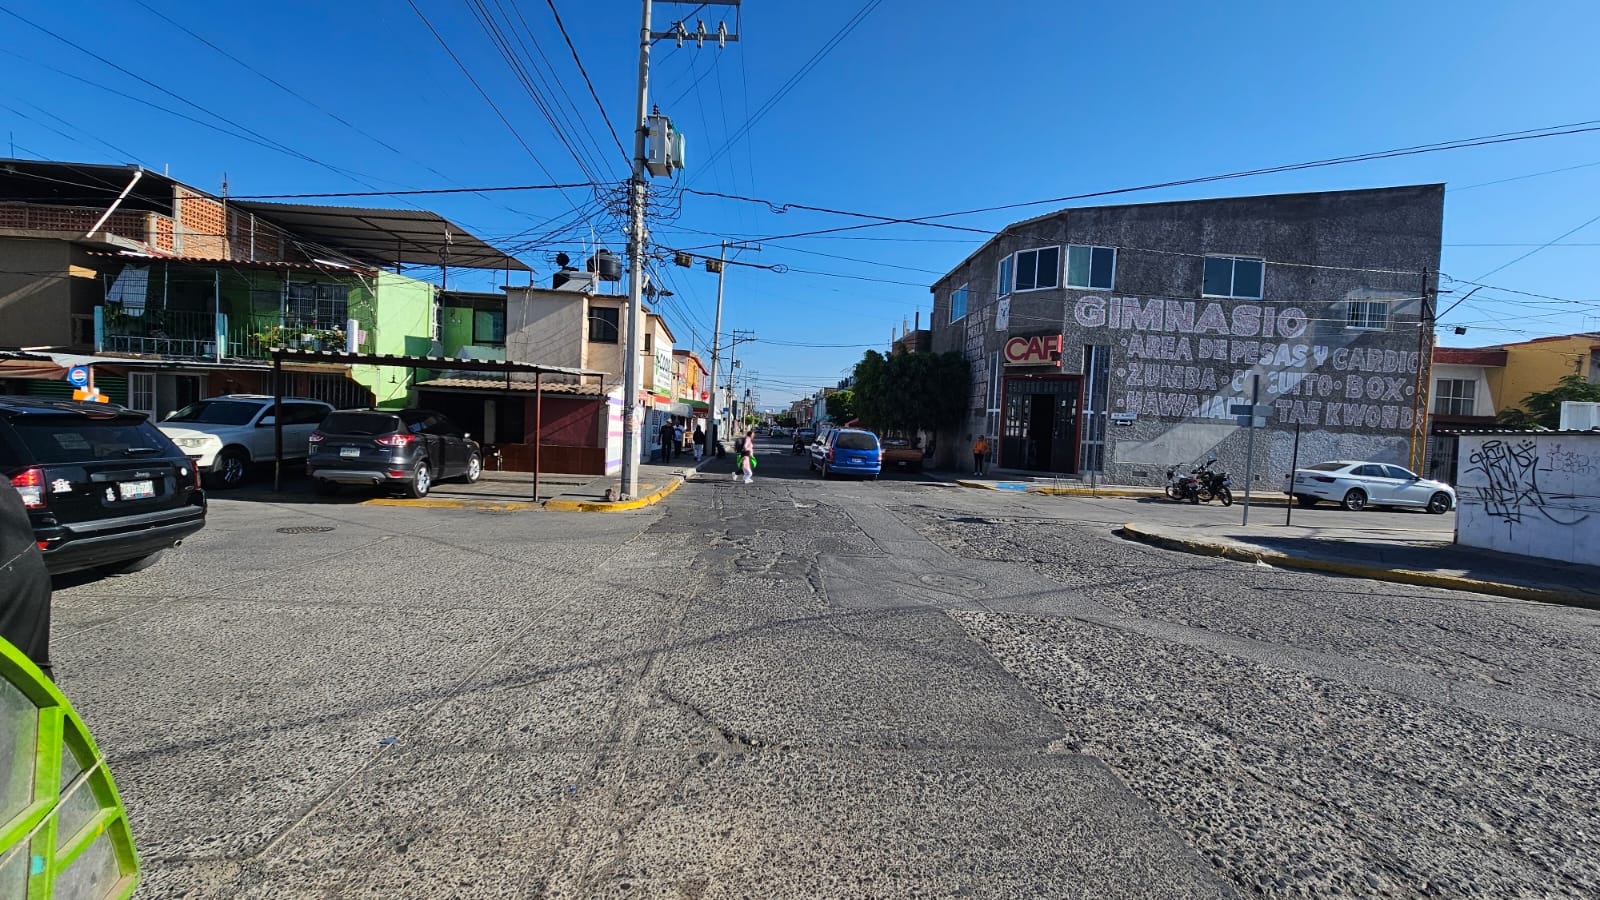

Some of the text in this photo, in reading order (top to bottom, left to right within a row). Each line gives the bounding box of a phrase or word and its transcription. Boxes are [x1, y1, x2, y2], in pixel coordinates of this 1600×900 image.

[1074, 295, 1308, 338] GIMNASIO
[1127, 334, 1418, 373] AREA DE PESAS Y CARDIO
[1126, 362, 1406, 401] ZUMBA CCUITO BOX
[1126, 390, 1260, 420] HAWAIAN
[1276, 399, 1322, 425] TAE
